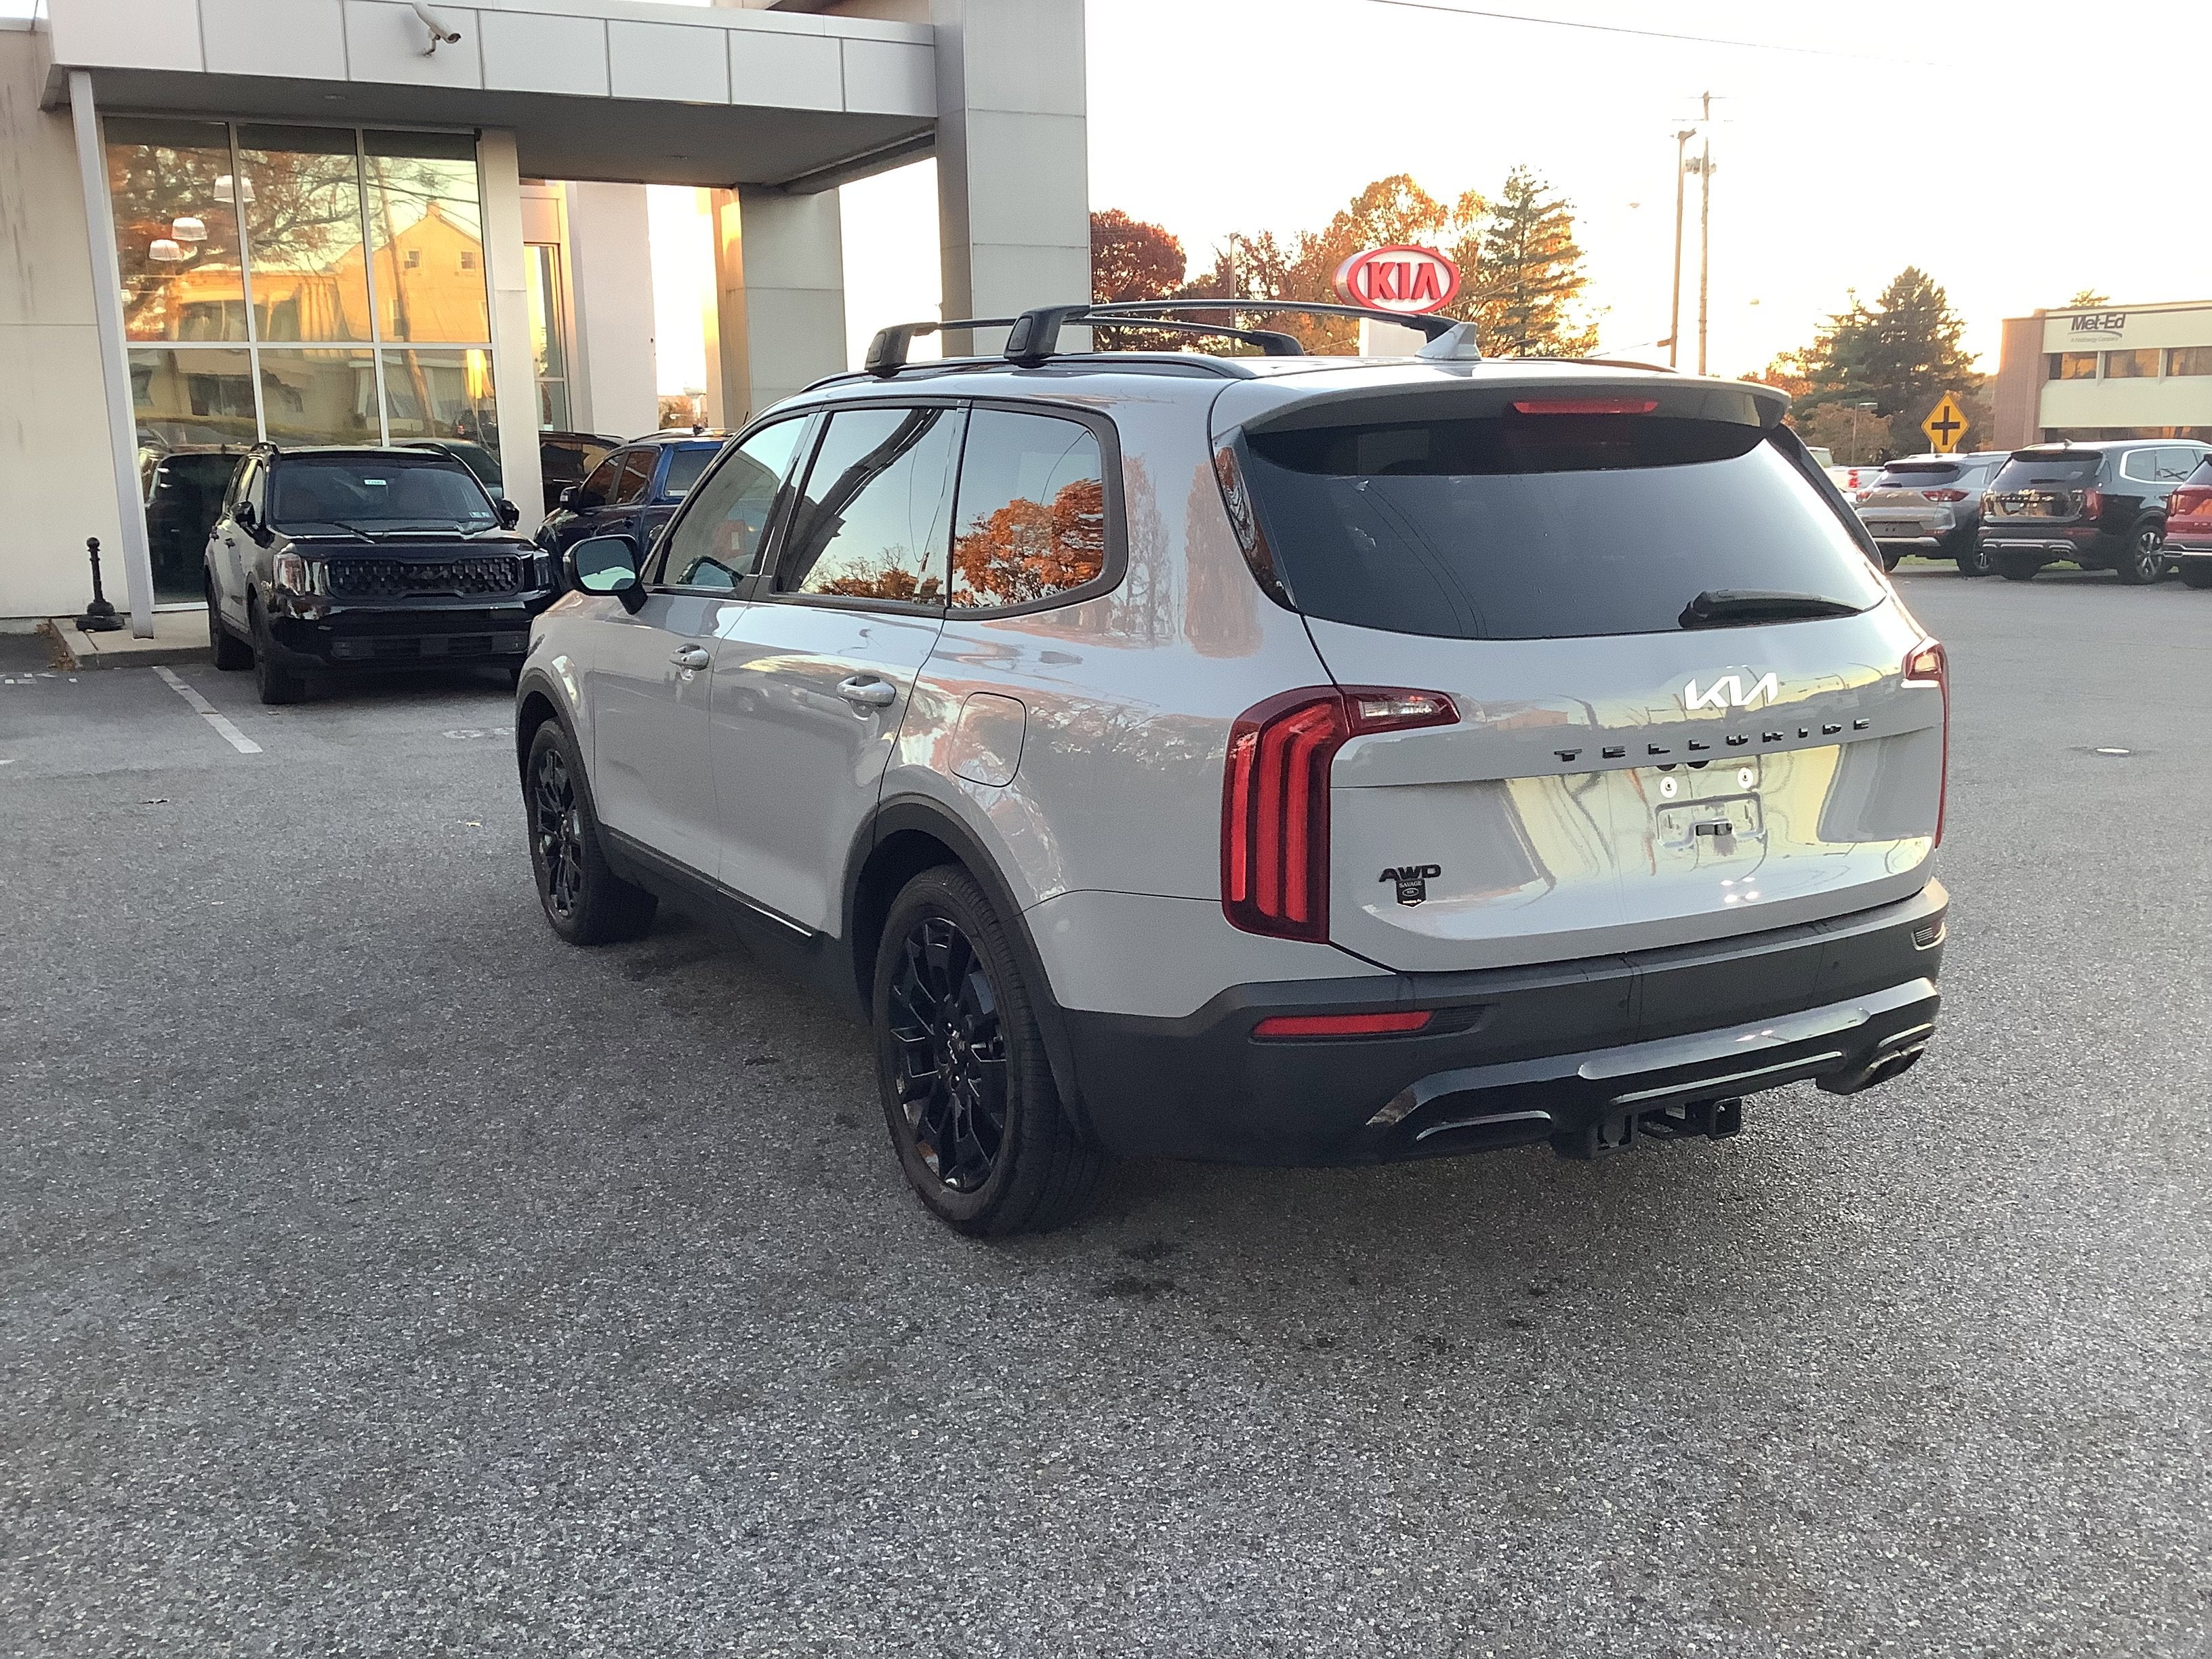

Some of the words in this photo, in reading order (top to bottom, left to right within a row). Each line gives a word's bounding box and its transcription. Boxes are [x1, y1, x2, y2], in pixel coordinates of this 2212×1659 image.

[1366, 262, 1441, 300] KIA
[2071, 313, 2126, 331] Met-Ed
[1683, 669, 1778, 710] KIA
[1554, 718, 1870, 762] TELLURIDE
[1378, 864, 1441, 882] AWD
[1398, 880, 1422, 888] SAVAGE
